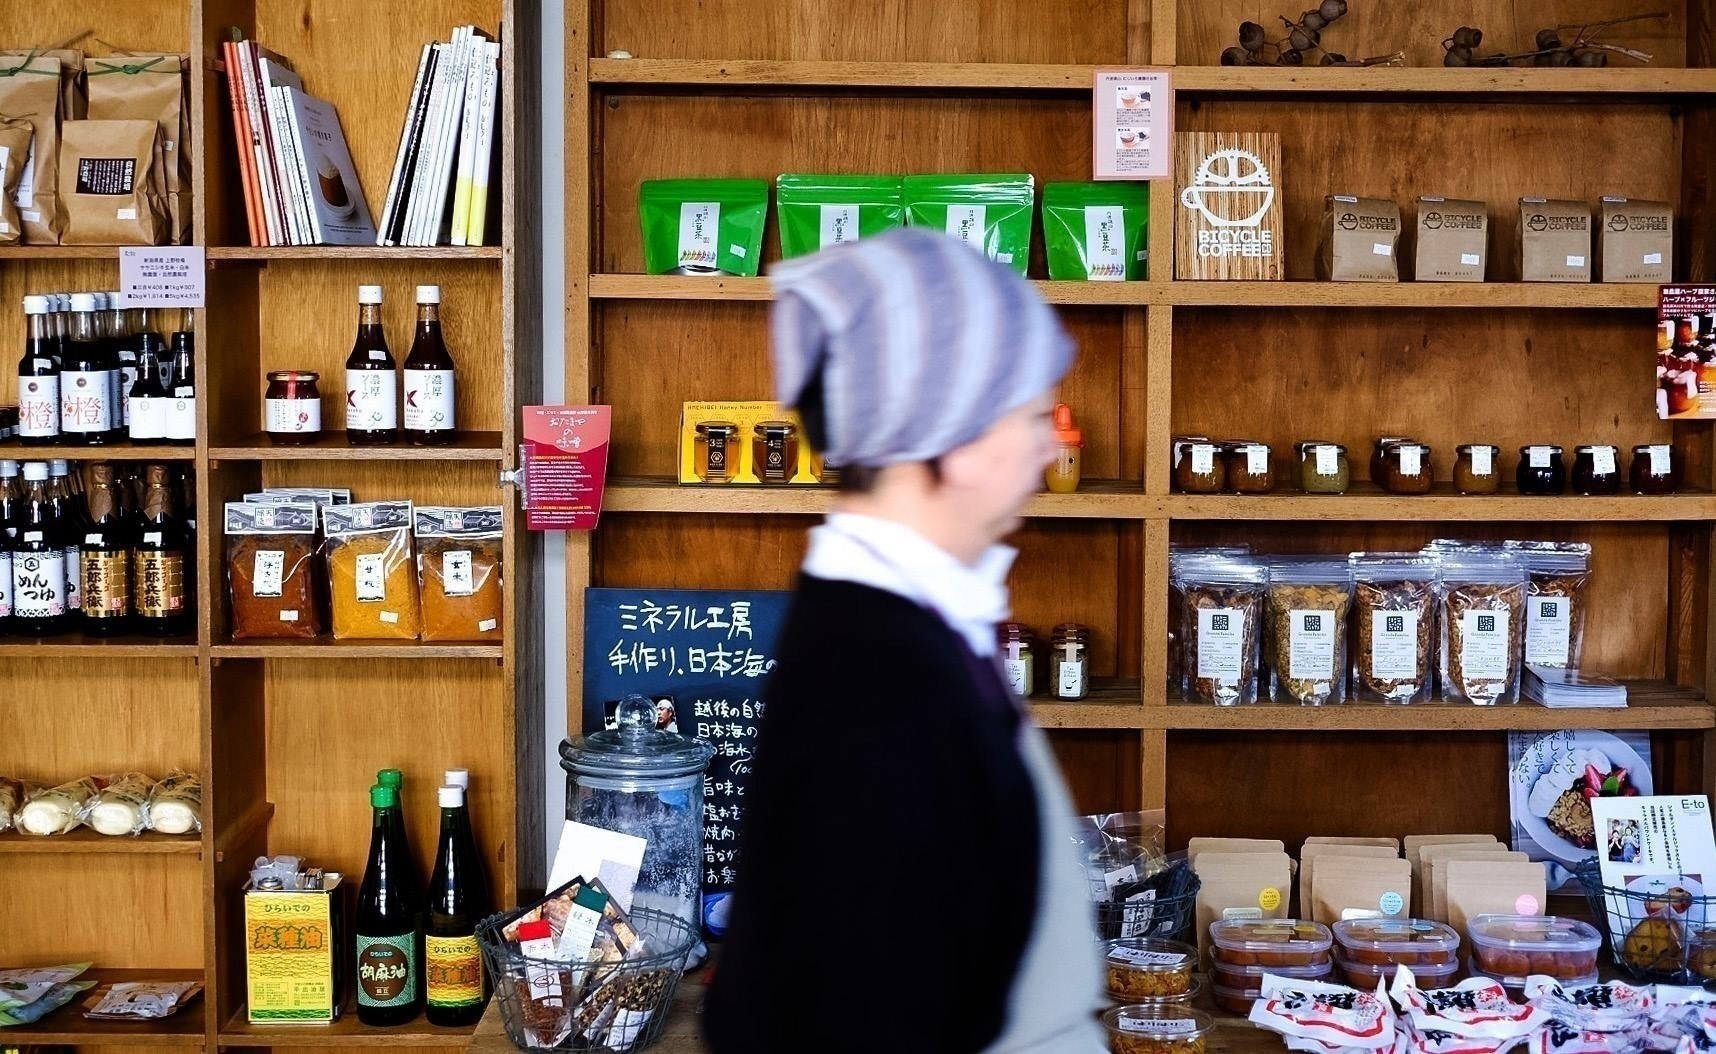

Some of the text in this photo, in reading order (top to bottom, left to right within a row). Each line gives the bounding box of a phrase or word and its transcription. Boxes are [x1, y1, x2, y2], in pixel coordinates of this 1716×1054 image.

[1198, 230, 1272, 243] BICYCLE
[1198, 243, 1261, 257] COFFEE
[709, 438, 717, 447] 3
[767, 439, 775, 448] 4
[18, 572, 48, 589] めん
[86, 559, 103, 608] 五郎兵衛
[144, 559, 162, 608] 五郎兵衛
[24, 588, 56, 602] つゆ
[618, 599, 754, 642] ミネラル工房
[1681, 798, 1706, 811] E-to
[264, 903, 311, 914] ひらいでの
[253, 922, 324, 951] 菜種油
[433, 945, 473, 956] ひらいでの
[359, 962, 408, 983] 胡麻油
